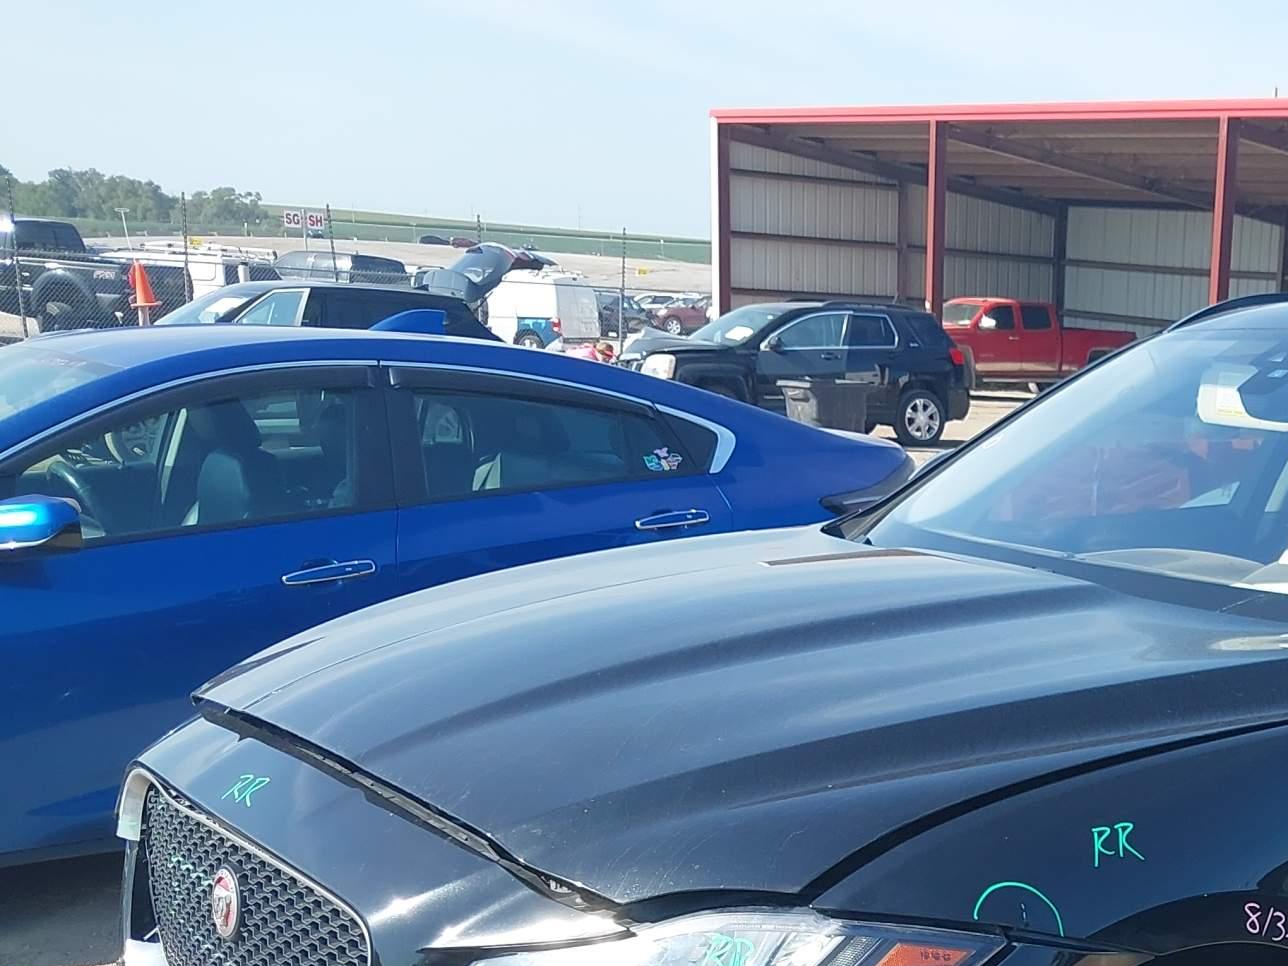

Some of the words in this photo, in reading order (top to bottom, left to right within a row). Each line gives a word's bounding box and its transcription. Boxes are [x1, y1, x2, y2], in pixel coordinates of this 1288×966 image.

[285, 212, 300, 225] SG
[308, 214, 323, 227] SH
[221, 774, 271, 807] RR
[1091, 822, 1145, 867] RR
